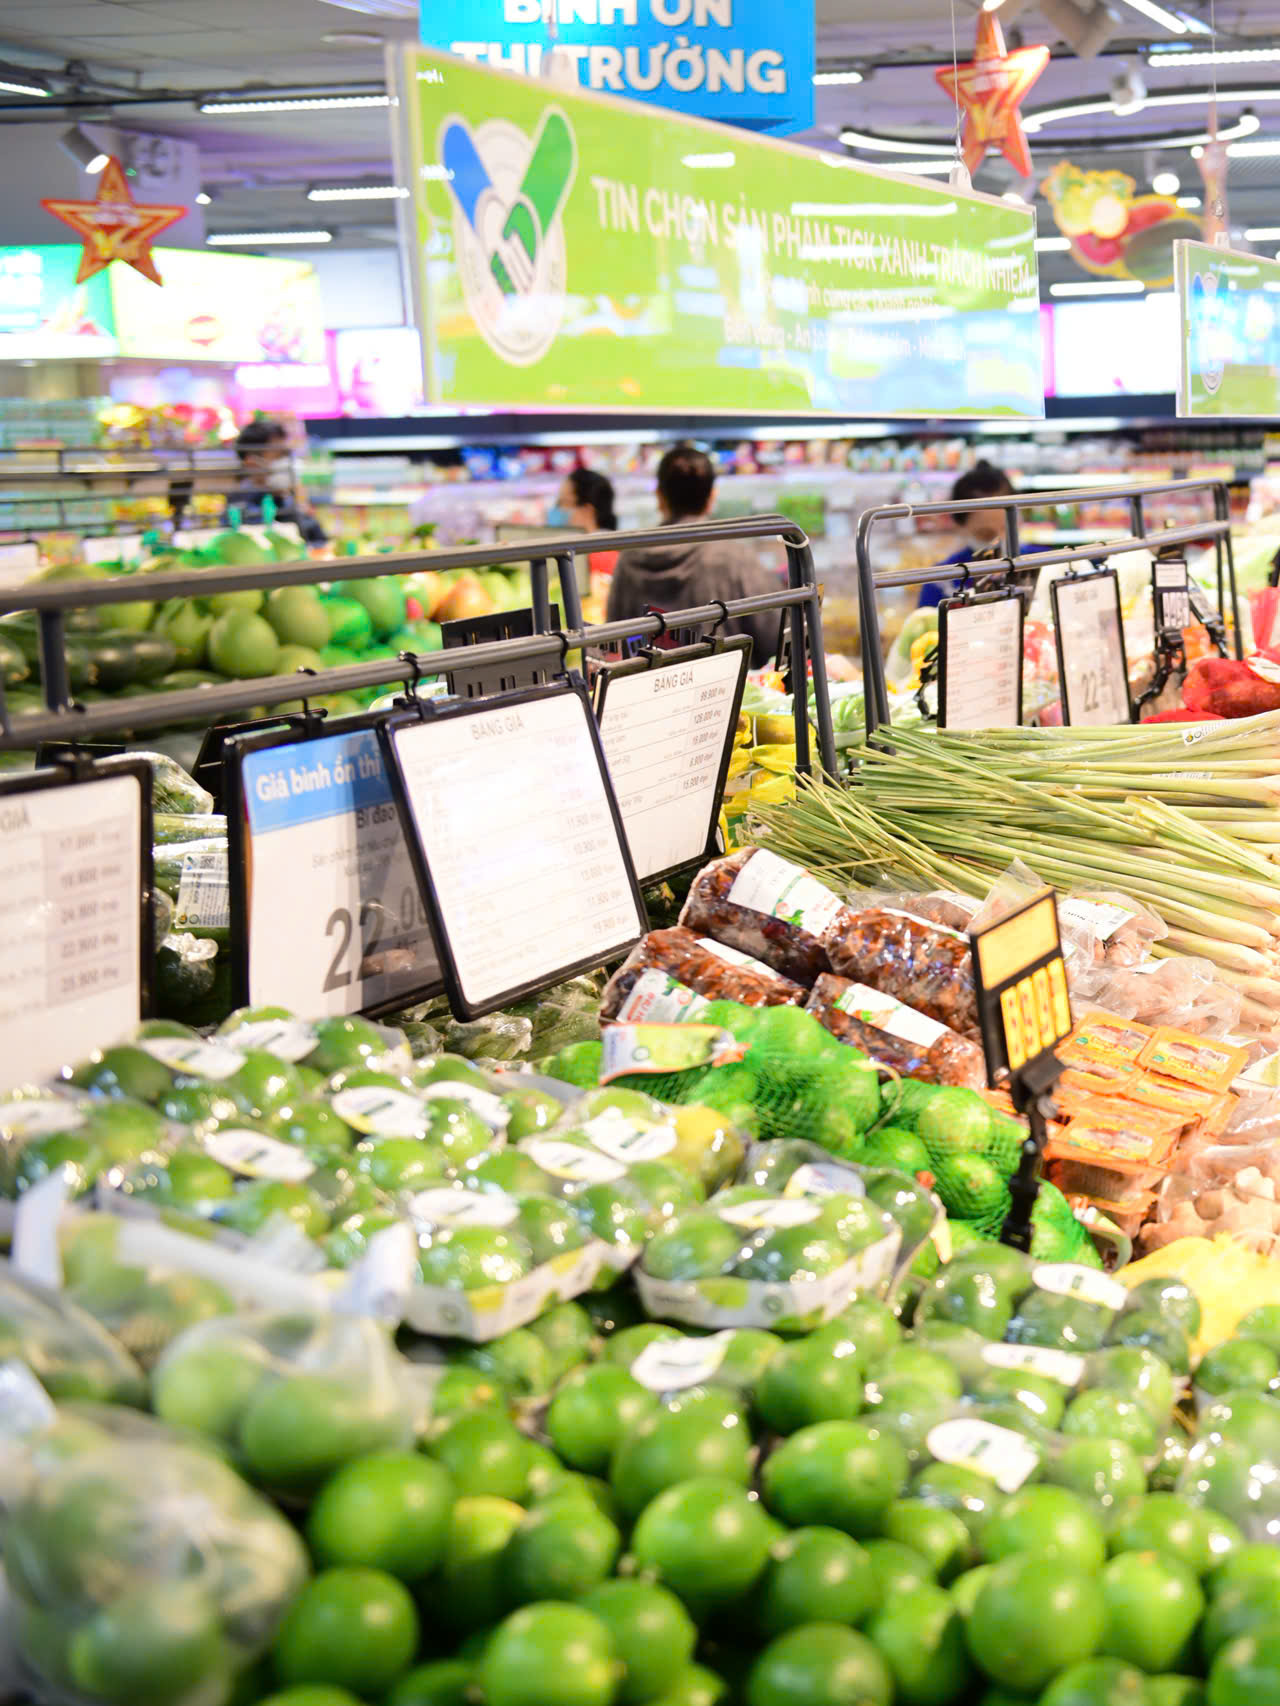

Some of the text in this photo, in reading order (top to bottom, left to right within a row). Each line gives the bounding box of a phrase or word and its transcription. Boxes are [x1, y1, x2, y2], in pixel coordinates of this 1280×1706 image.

[551, 35, 788, 93] TRƯỜNG
[589, 174, 640, 234] TIN
[643, 186, 719, 256] CHỌN
[878, 232, 928, 279] XANH
[256, 770, 290, 801] Giá
[289, 761, 332, 795] bình
[333, 751, 356, 784] ổn
